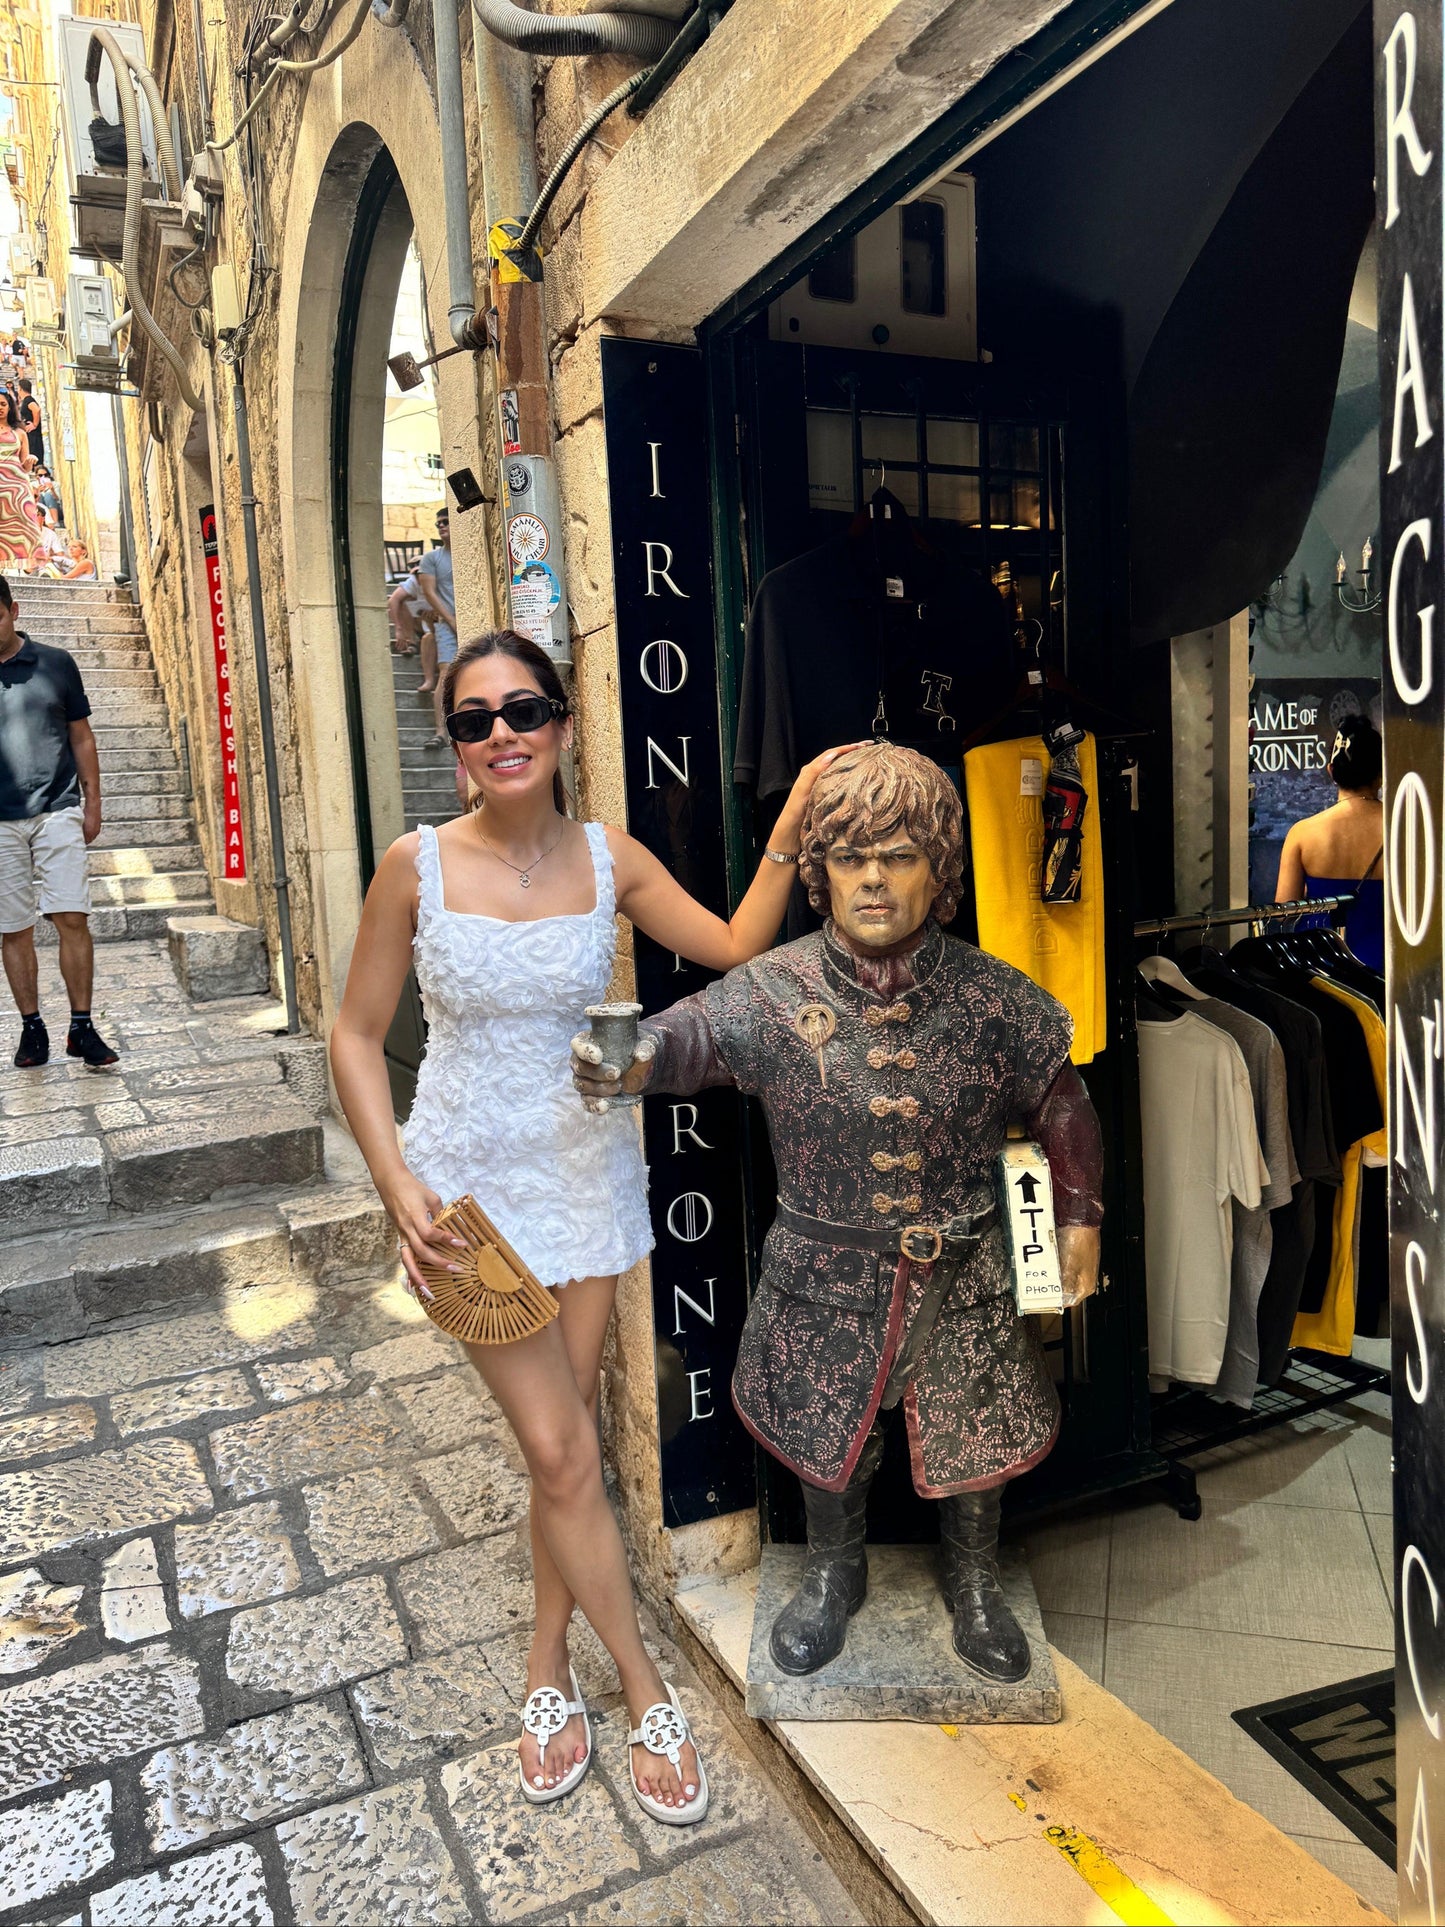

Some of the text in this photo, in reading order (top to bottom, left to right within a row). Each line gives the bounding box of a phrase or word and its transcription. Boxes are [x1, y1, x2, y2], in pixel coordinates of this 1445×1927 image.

[639, 441, 692, 790] IRON
[212, 565, 241, 869] FOOD & SUSHI BAR
[1248, 702, 1318, 731] AME OF
[1249, 741, 1327, 772] RONES
[1019, 1207, 1044, 1264] TIP
[1025, 1270, 1048, 1279] FOR
[1025, 1284, 1061, 1295] PHOTO
